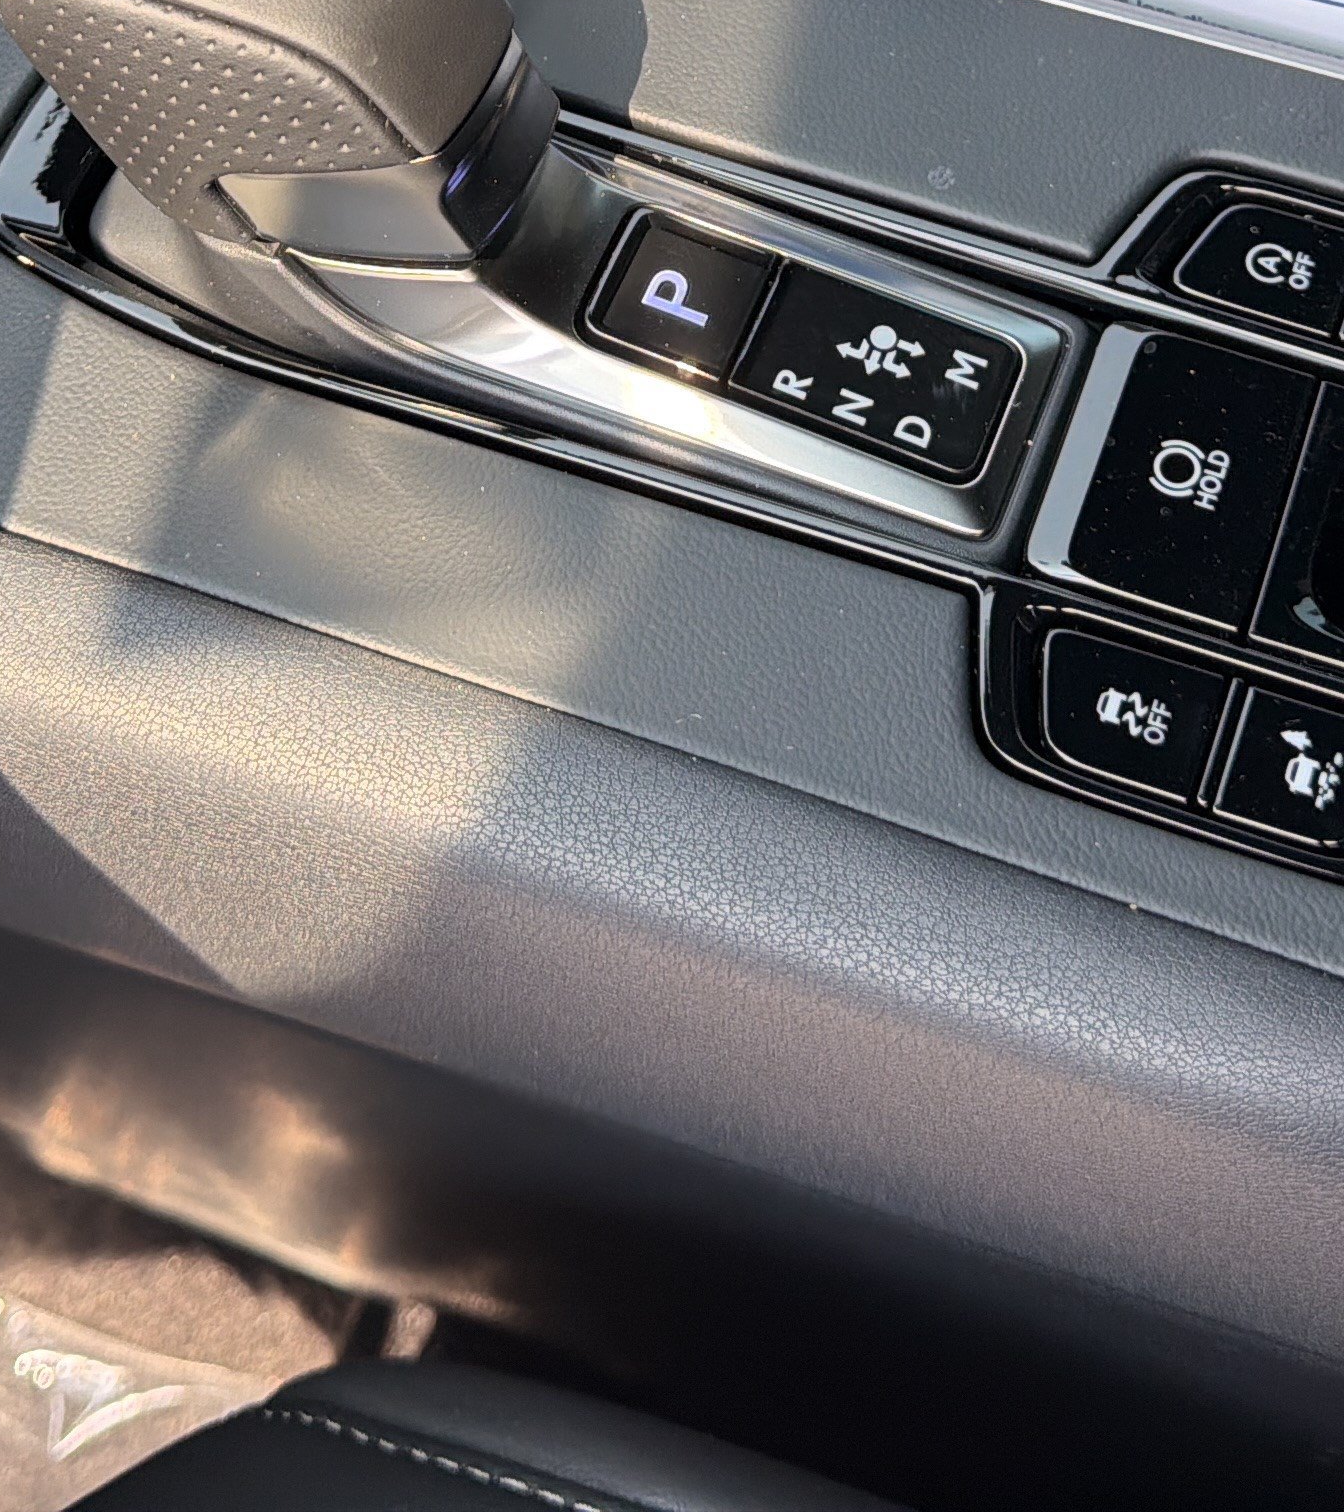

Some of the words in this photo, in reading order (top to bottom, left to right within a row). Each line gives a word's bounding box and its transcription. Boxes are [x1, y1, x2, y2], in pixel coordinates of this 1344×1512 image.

[1288, 249, 1317, 292] OFF
[640, 269, 710, 328] P
[772, 368, 815, 401] R
[945, 349, 989, 391] M
[831, 387, 875, 427] N
[893, 414, 933, 449] D
[1194, 449, 1231, 512] HOLD
[1142, 698, 1174, 747] OFF
